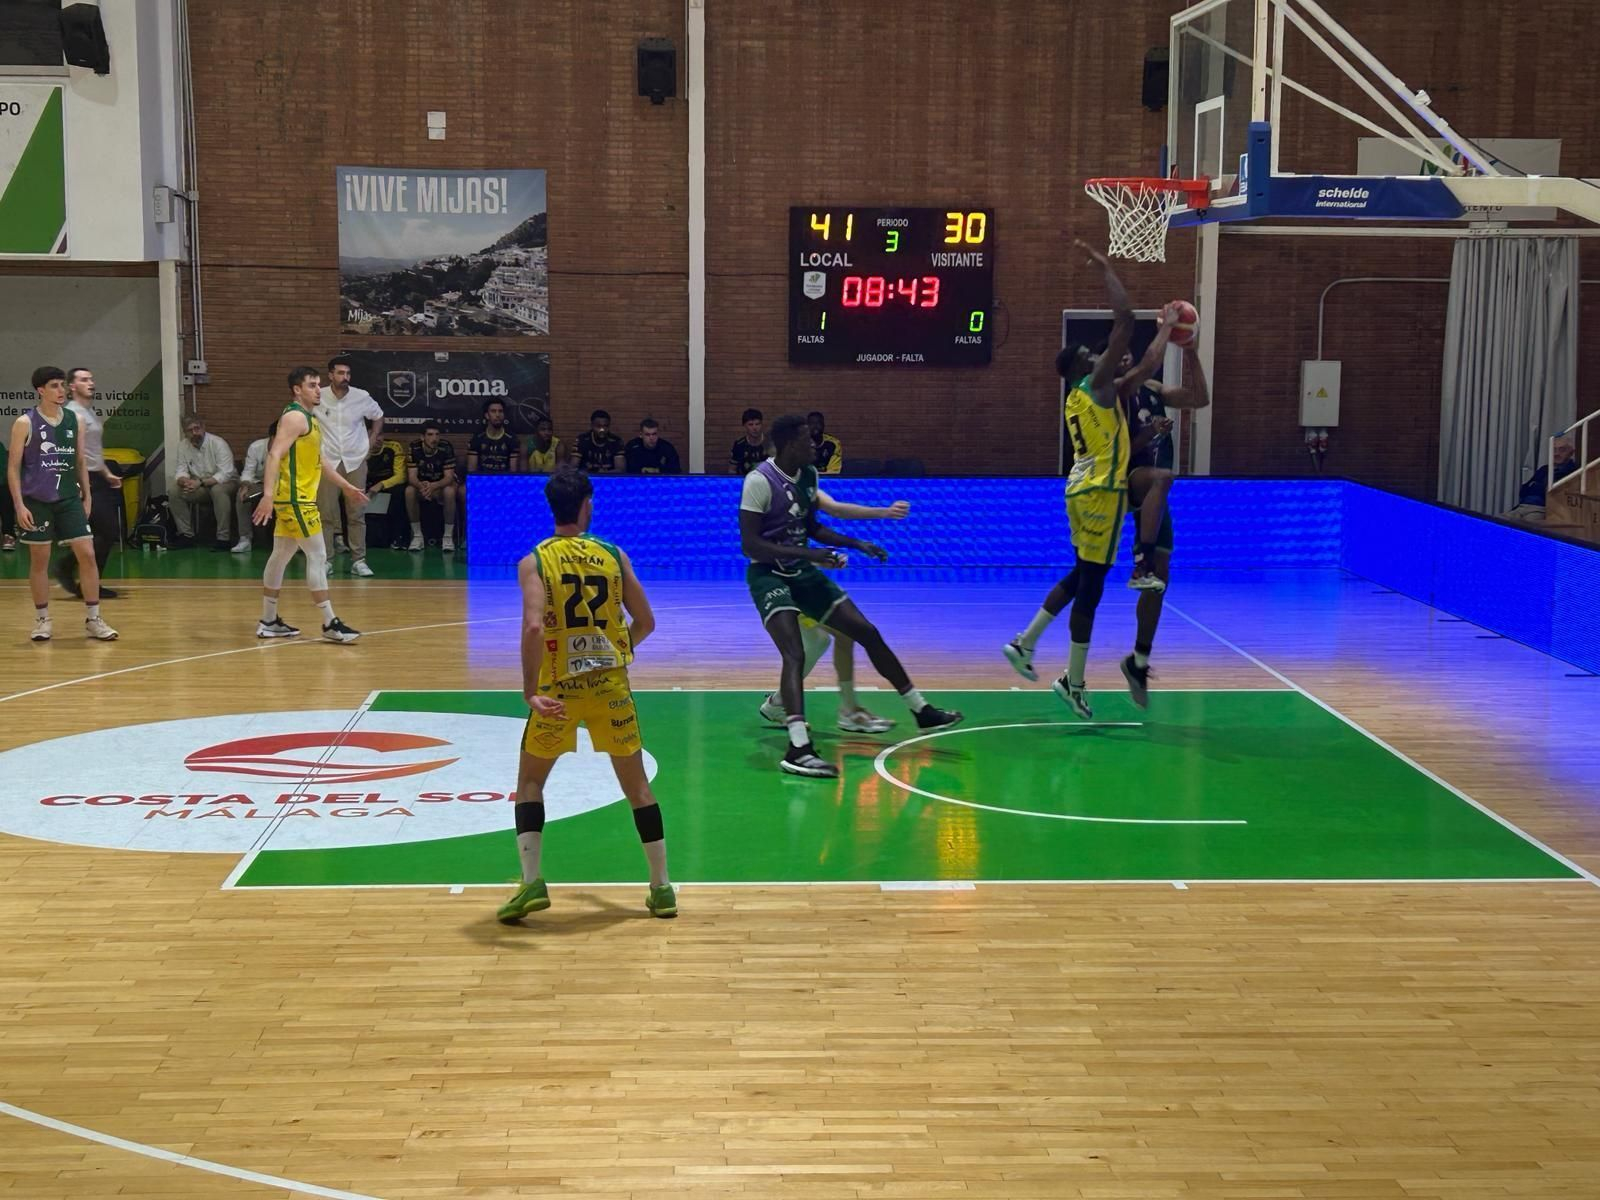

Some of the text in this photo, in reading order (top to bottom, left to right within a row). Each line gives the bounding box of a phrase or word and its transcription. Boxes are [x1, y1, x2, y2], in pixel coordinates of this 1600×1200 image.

[345, 174, 508, 214] ¡VIVE MIJAS!
[1318, 187, 1370, 199] schelde
[1315, 200, 1367, 208] international
[811, 213, 853, 241] 41
[876, 218, 909, 227] PERIODO
[944, 212, 987, 244] 30
[885, 231, 899, 252] 3
[800, 252, 853, 267] LOCAL
[931, 252, 984, 267] VISITANTE
[842, 276, 940, 308] 08:43
[820, 311, 827, 330] 1
[969, 311, 984, 332] 0
[798, 335, 825, 343] FALTAS
[955, 336, 982, 344] FALTAS
[856, 353, 894, 362] JUGADOR
[901, 353, 924, 362] FALTA
[105, 390, 150, 401] victoria
[55, 474, 62, 490] 7
[561, 573, 608, 629] 22
[39, 791, 517, 806] COSTA DEL SO
[143, 805, 416, 819] MÁLAGA
